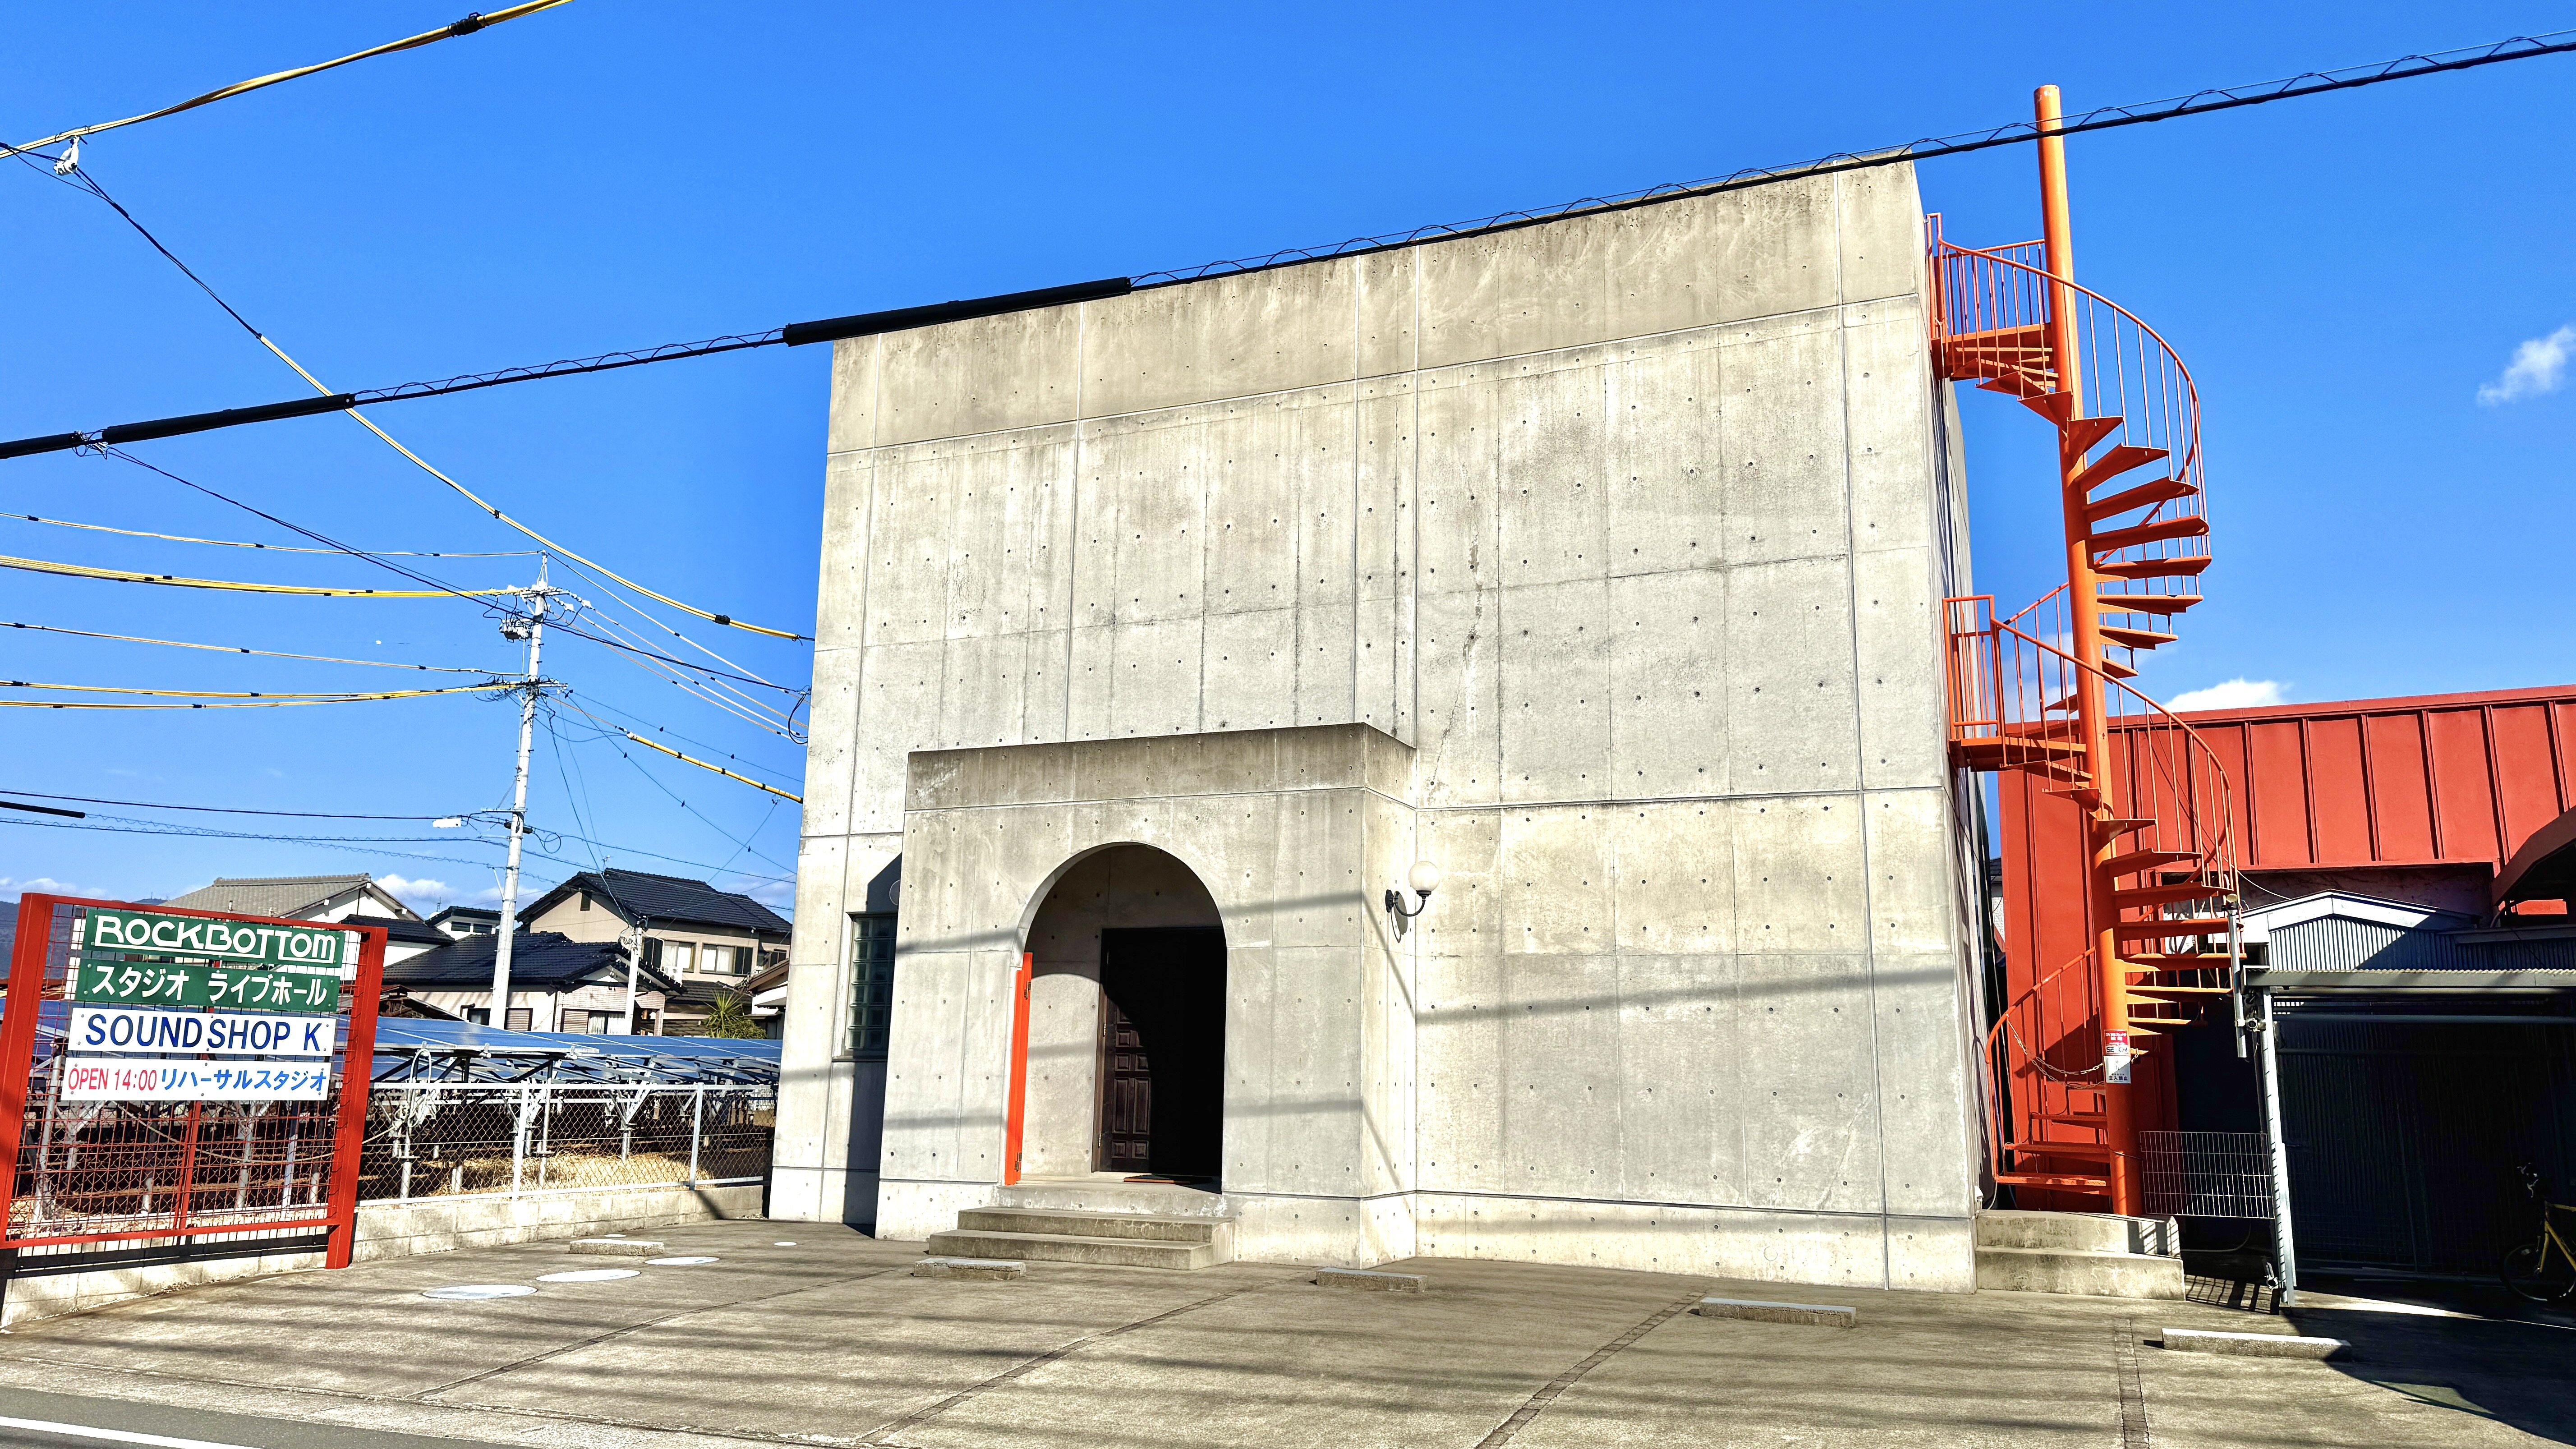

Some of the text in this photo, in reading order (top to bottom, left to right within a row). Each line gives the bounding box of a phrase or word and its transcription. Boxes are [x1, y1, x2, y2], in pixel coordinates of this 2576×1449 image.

[92, 966, 327, 1006] スタジオ ライブホール
[86, 1014, 322, 1051] SOUND SHOP K
[69, 1068, 327, 1091] OPEN 14:00 リハーサルスタジオ
